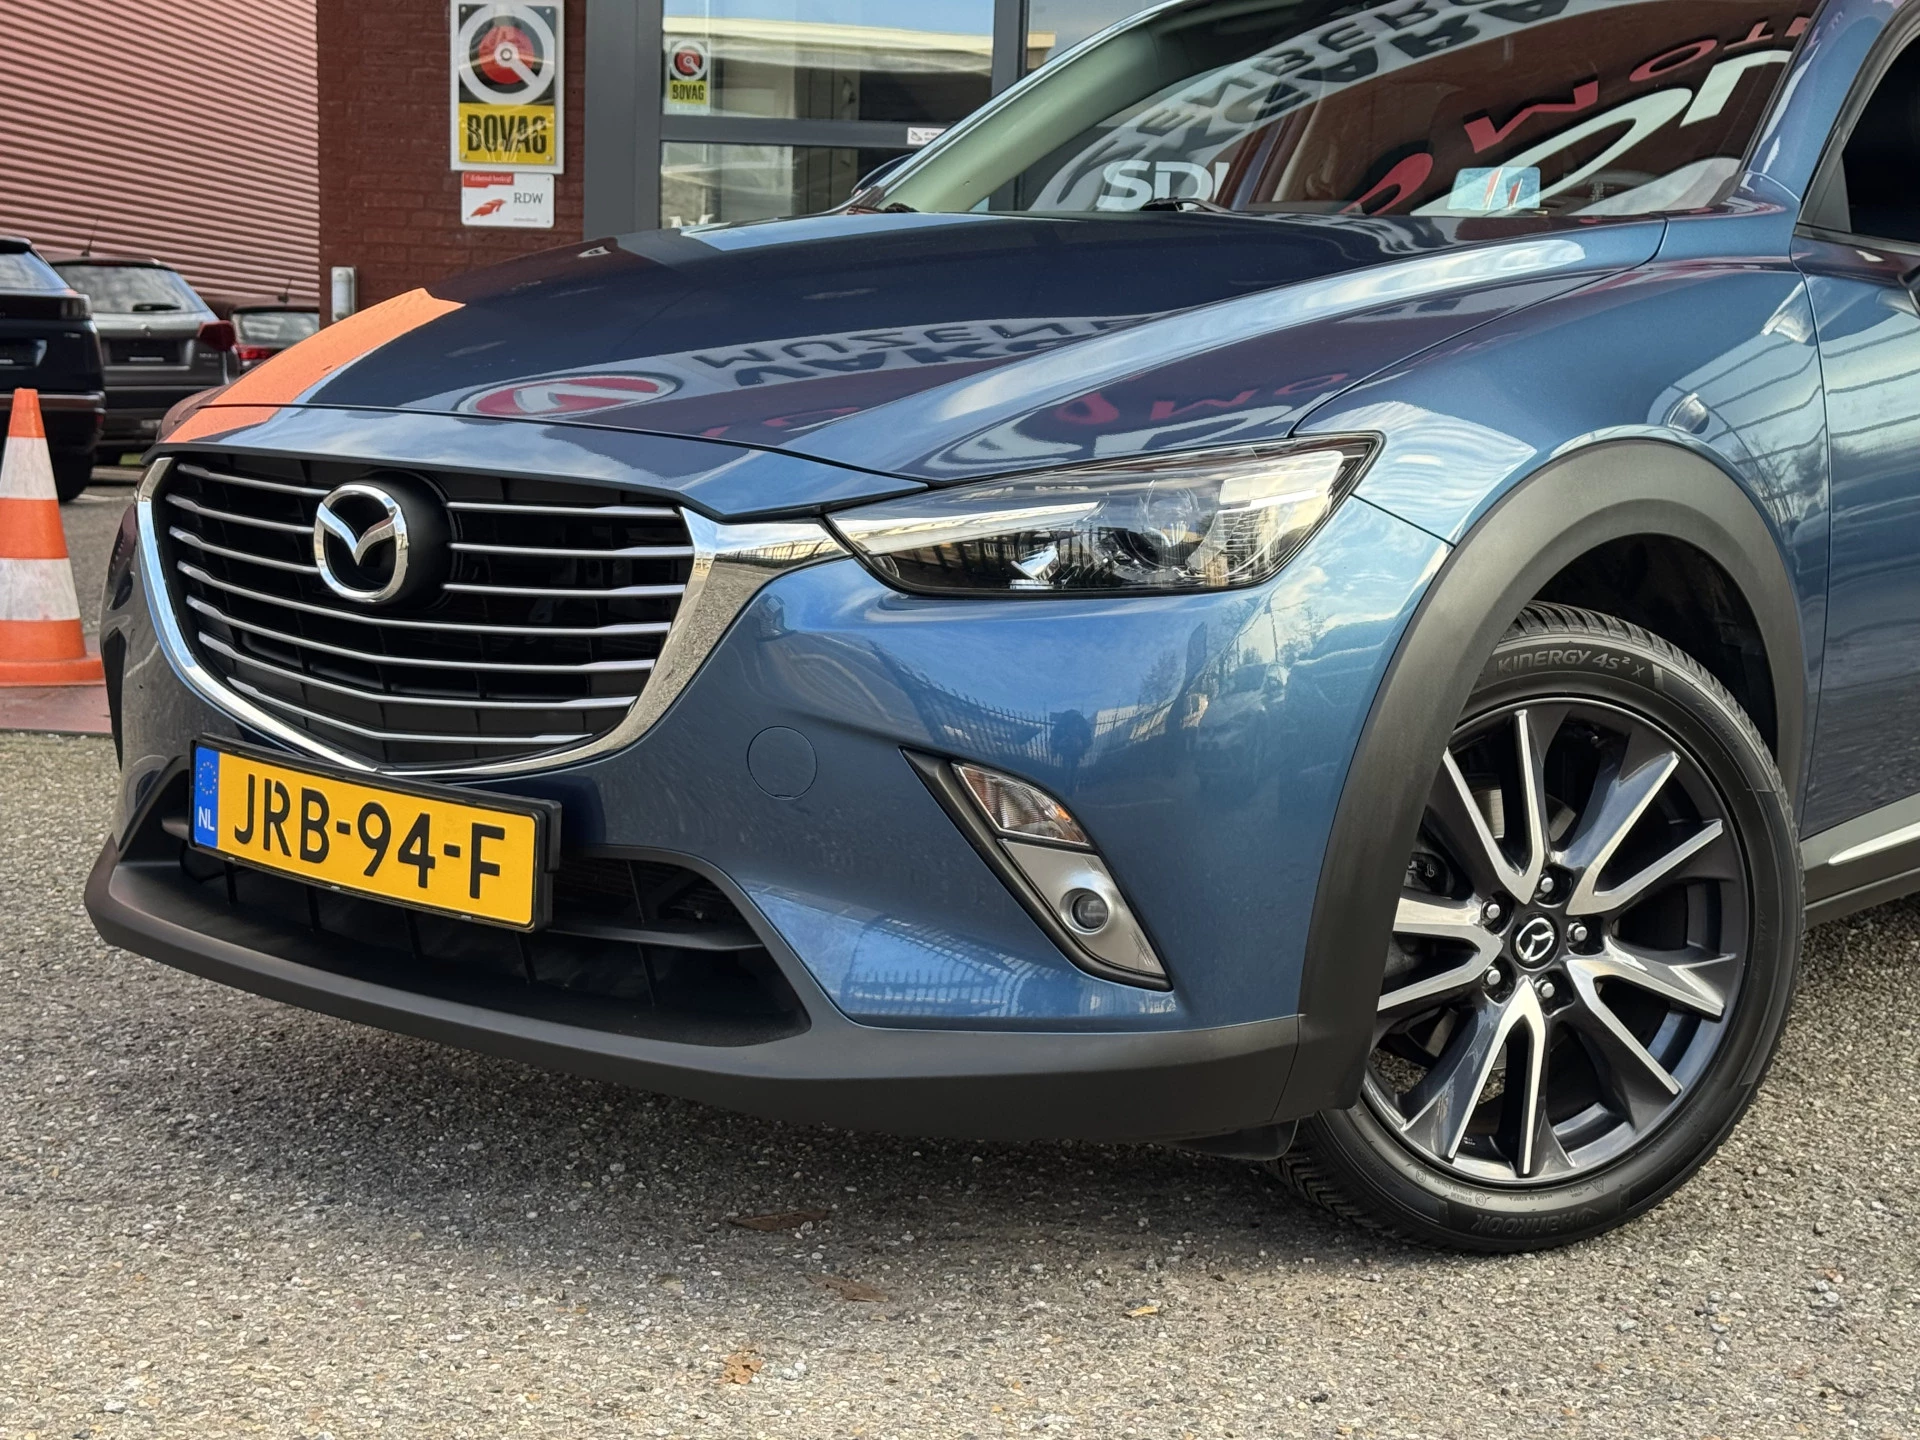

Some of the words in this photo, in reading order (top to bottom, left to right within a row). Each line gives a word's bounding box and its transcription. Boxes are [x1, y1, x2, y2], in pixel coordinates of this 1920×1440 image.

[672, 84, 704, 100] BOVAG
[467, 114, 547, 154] BOVAG
[513, 192, 543, 204] RDW
[198, 806, 215, 831] NL
[234, 773, 505, 899] JRB-94-F
